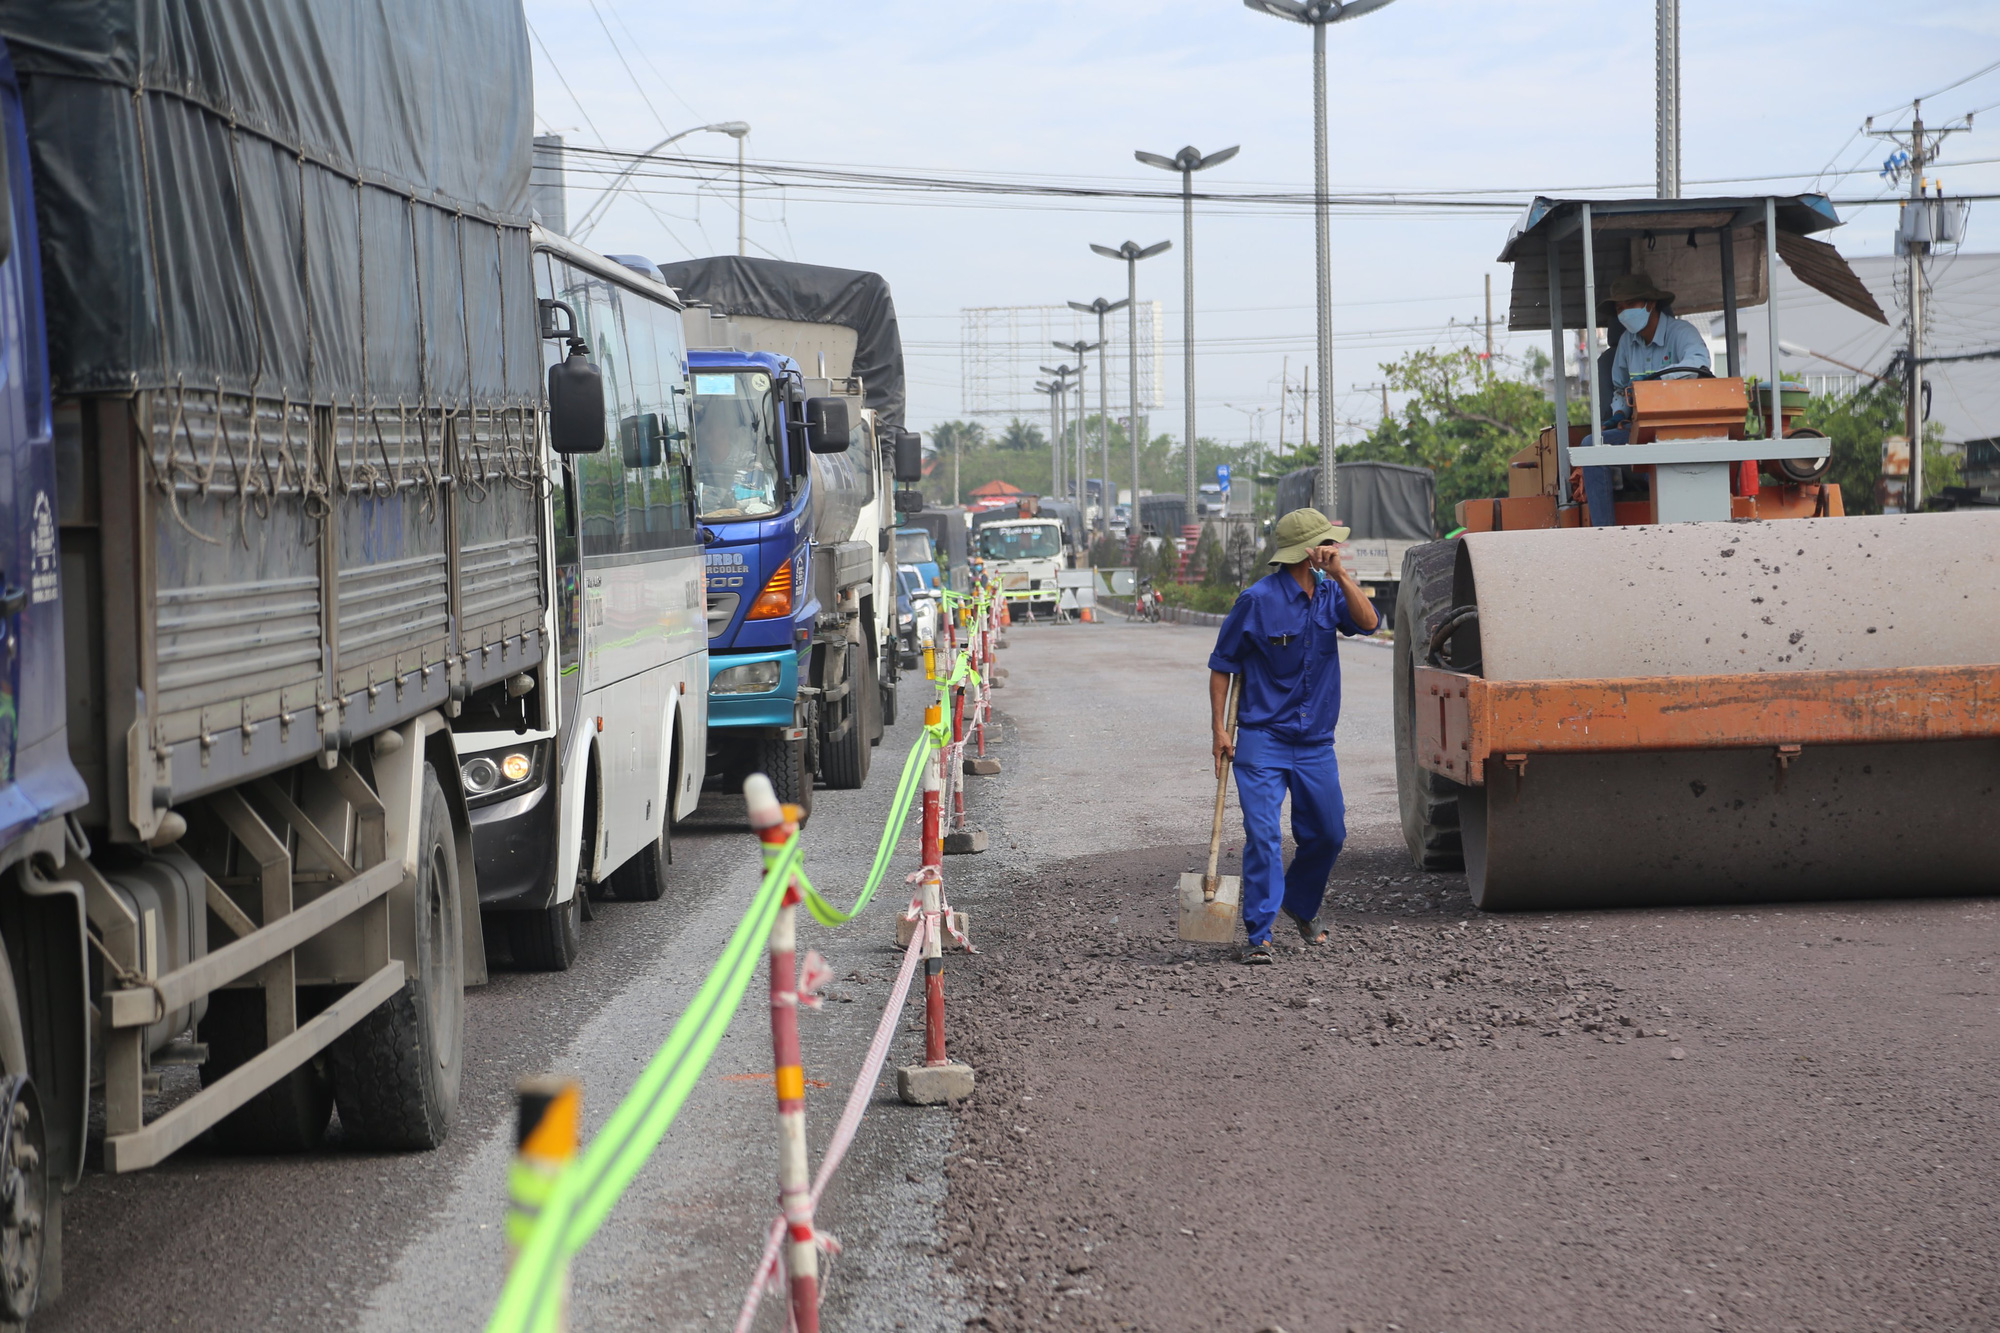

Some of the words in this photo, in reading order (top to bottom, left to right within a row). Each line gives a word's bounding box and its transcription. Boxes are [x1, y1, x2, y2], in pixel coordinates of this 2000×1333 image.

[706, 553, 743, 565] URBO
[706, 566, 749, 574] RCOOLER
[706, 577, 743, 587] 00
